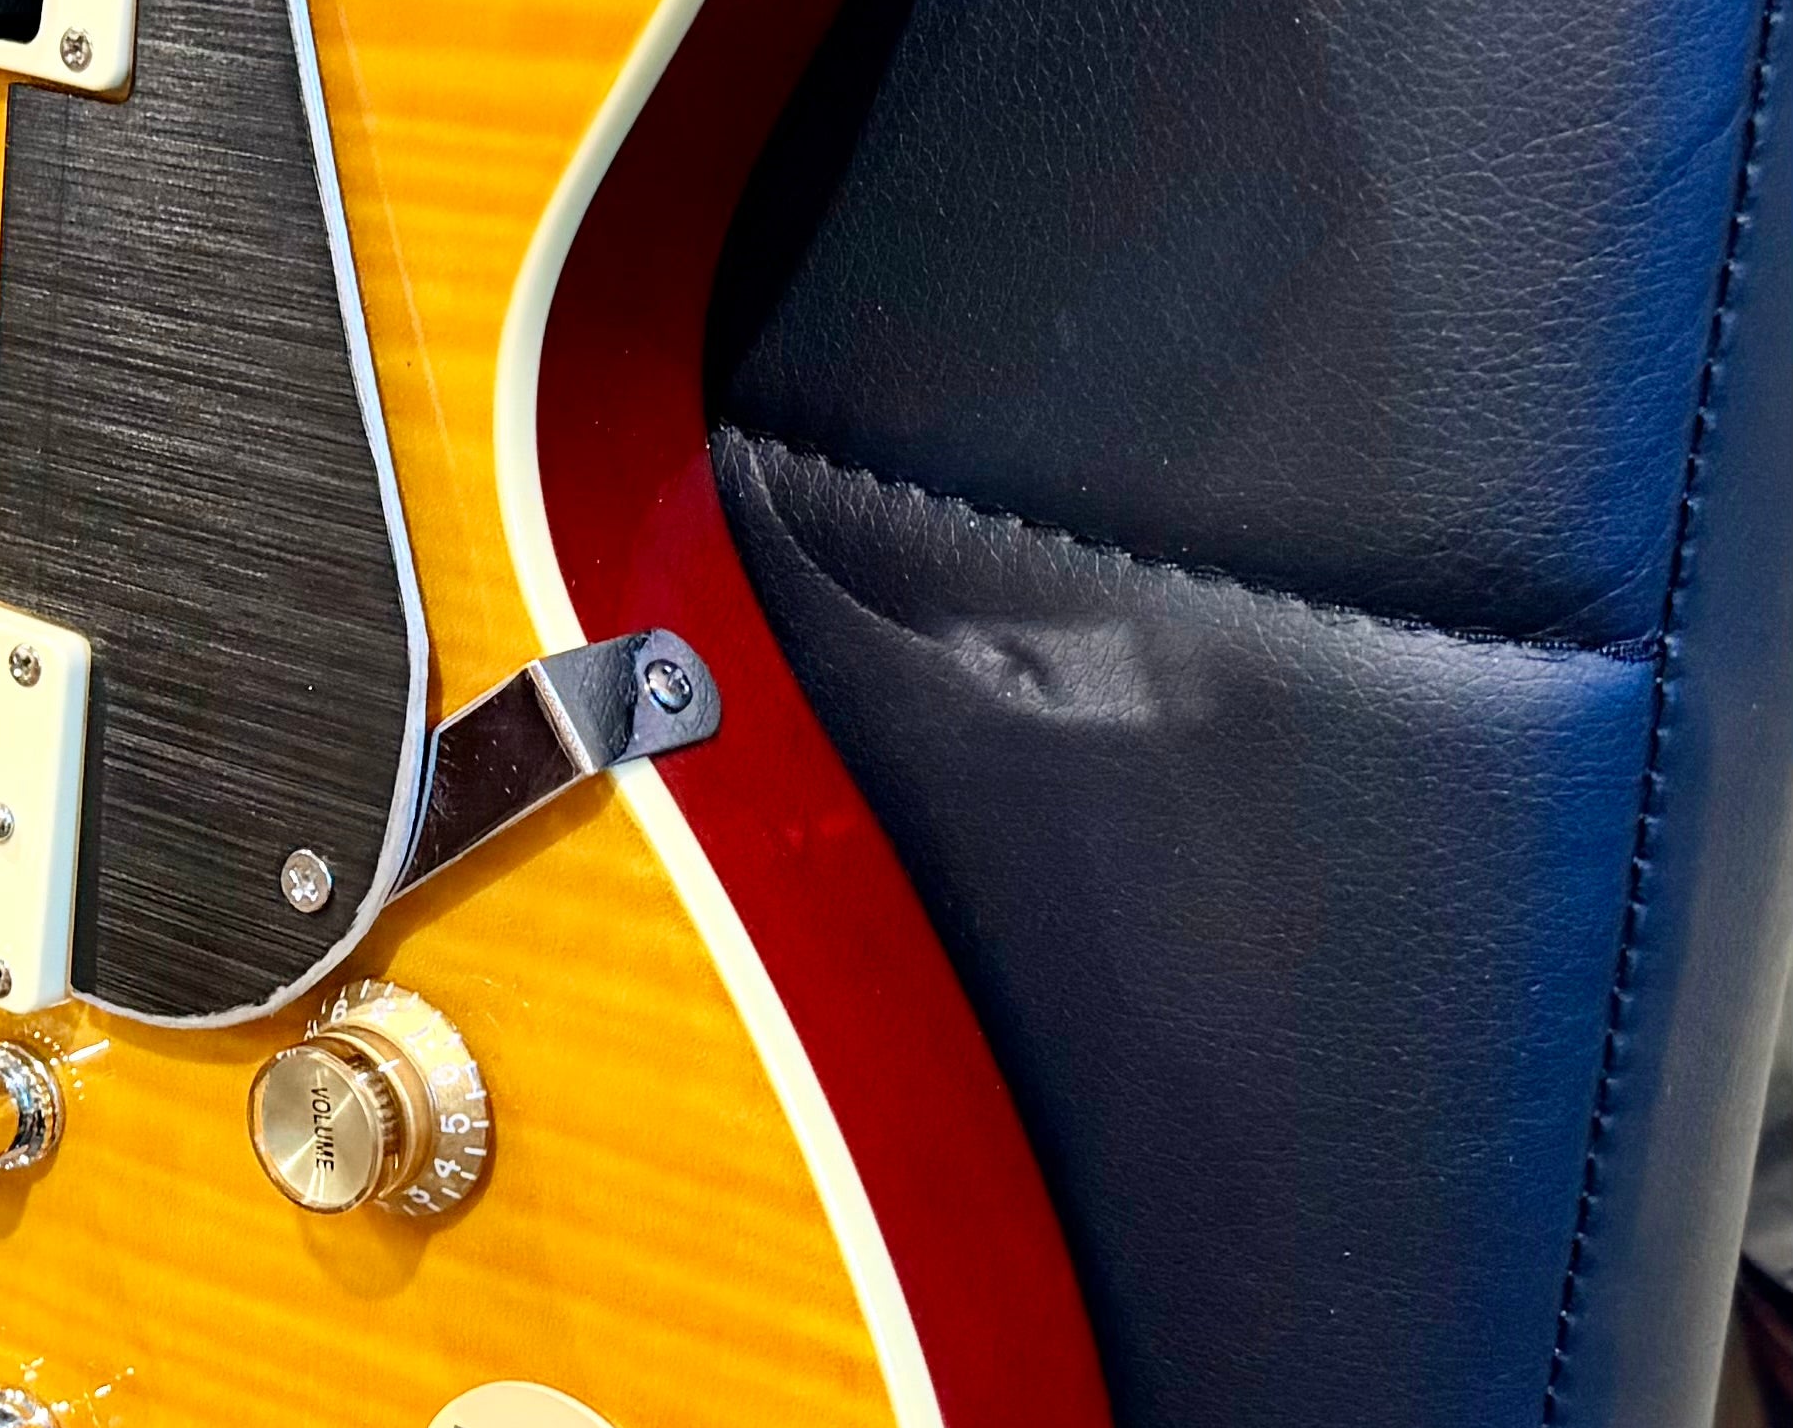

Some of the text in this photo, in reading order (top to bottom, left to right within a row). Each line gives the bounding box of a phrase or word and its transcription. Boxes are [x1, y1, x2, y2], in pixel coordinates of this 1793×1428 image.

[310, 1086, 335, 1173] VOLUME
[439, 1112, 471, 1135] 5
[434, 1157, 462, 1179] 4
